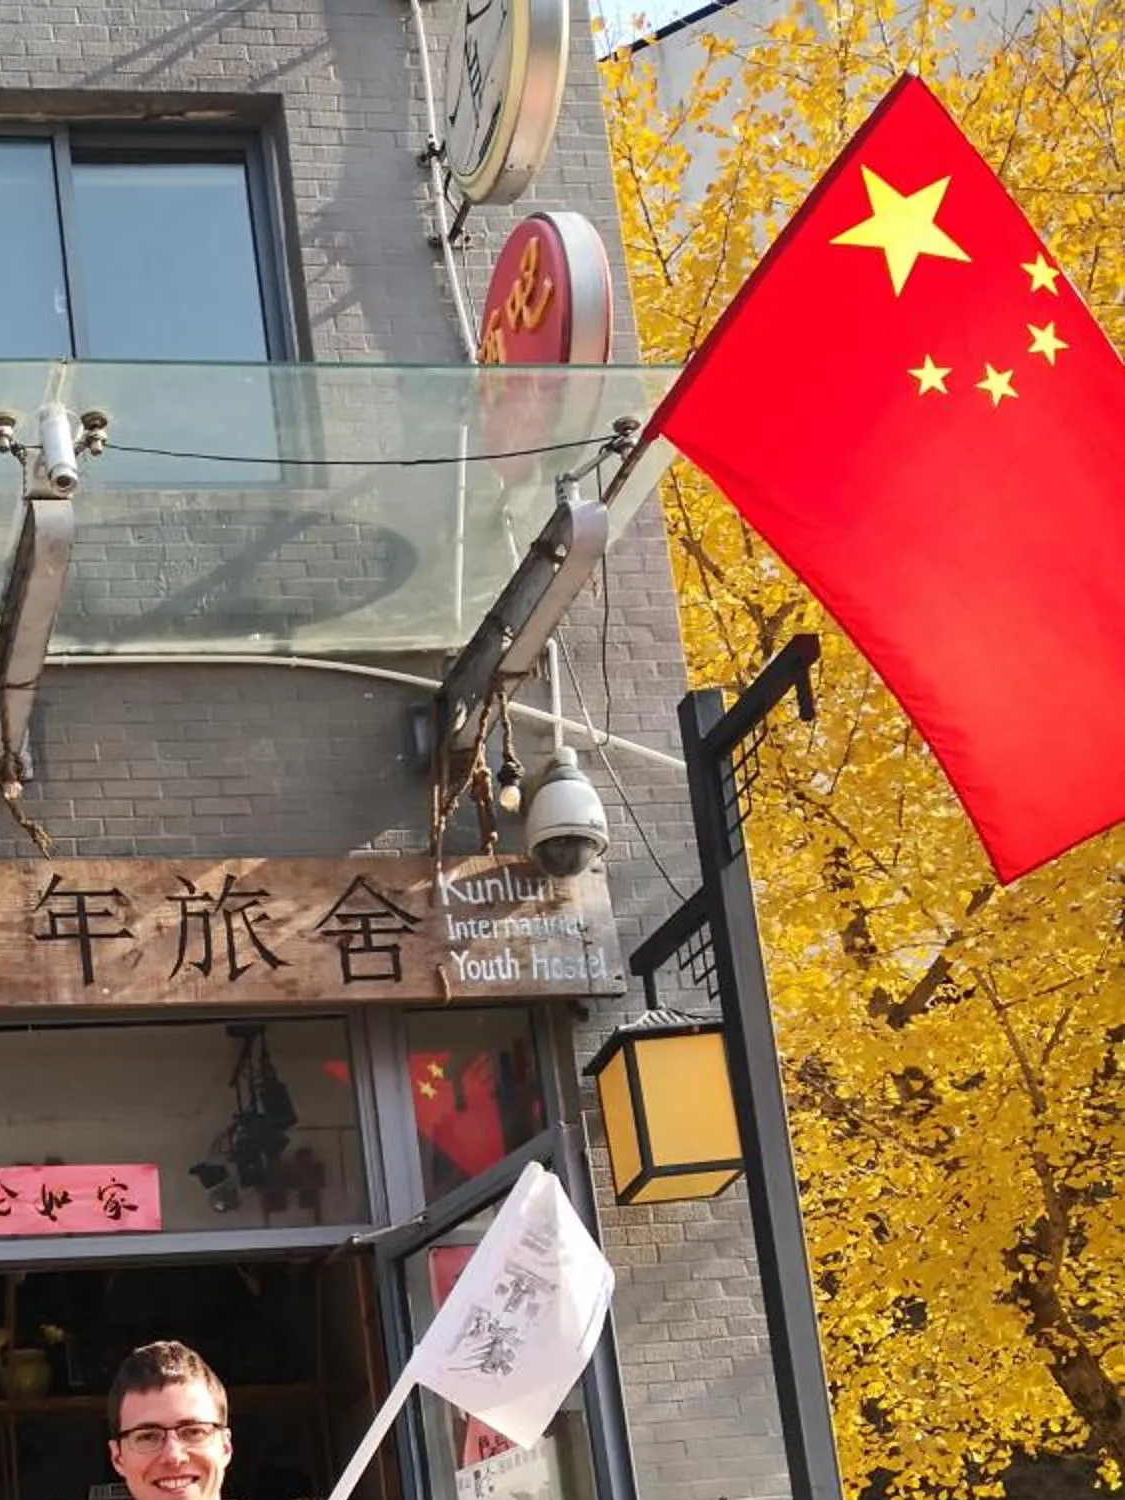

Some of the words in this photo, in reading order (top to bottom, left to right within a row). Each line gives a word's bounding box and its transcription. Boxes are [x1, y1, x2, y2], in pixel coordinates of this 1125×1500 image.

[438, 866, 555, 906] Kunlun
[450, 946, 521, 982] Youth
[531, 946, 608, 981] Hostel
